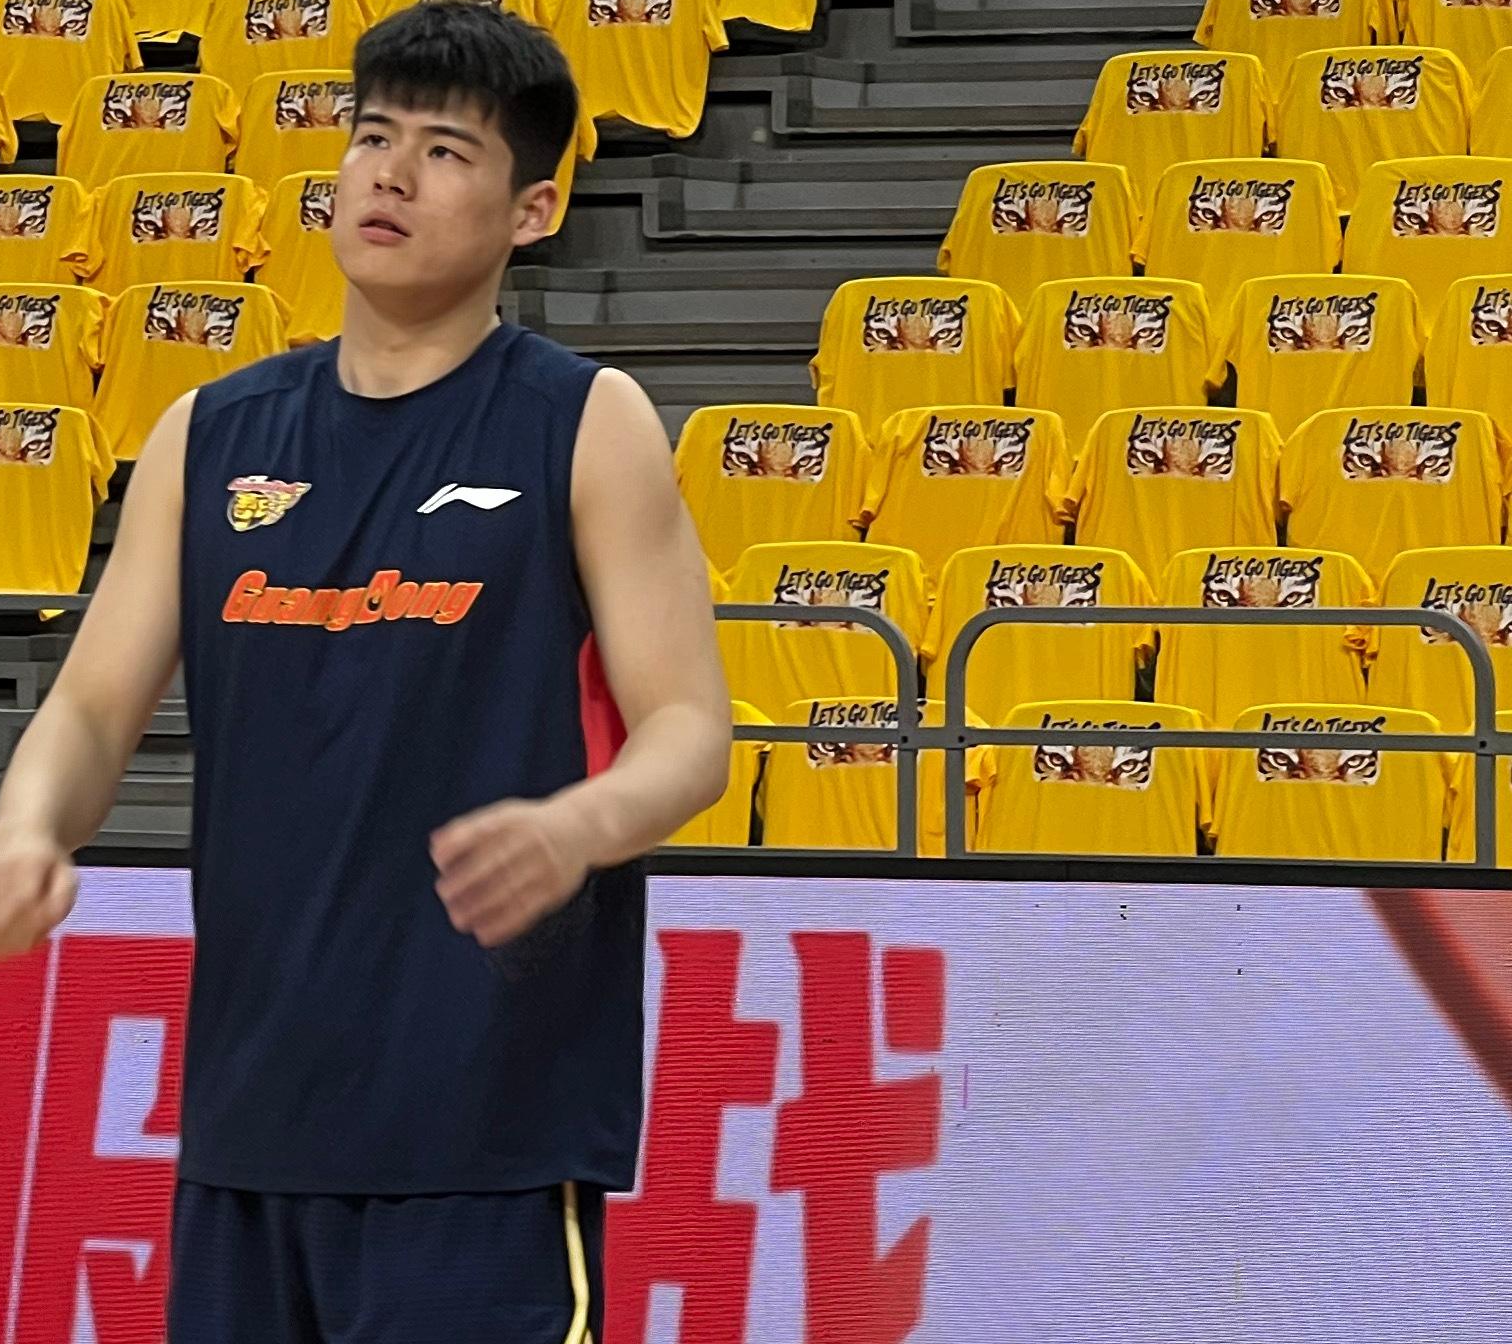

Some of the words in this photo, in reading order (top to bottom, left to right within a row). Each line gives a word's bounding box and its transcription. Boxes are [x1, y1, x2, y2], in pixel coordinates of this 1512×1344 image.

[1126, 62, 1161, 85] LET'S
[1161, 63, 1178, 79] GO
[1180, 59, 1227, 84] TIGERS
[1320, 56, 1356, 80] LET'S
[1357, 59, 1374, 75] GO
[1376, 56, 1424, 80] TIGERS
[10, 185, 54, 210] TIGERS
[992, 178, 1028, 202] LET'S
[1028, 181, 1046, 198] GO
[1048, 181, 1095, 206] TIGERS
[1189, 176, 1226, 199] LET'S
[1226, 180, 1244, 196] GO
[1245, 179, 1294, 204] TIGERS
[1393, 180, 1431, 205] LET'S
[1432, 183, 1450, 200] GO
[1452, 180, 1503, 206] TIGERS
[862, 295, 899, 320] LET'S
[900, 298, 918, 316] GO
[920, 295, 969, 321] TIGERS
[1064, 290, 1102, 315] LET'S
[1102, 295, 1121, 312] GO
[1123, 295, 1173, 320] TIGERS
[723, 417, 761, 443] LET'S
[761, 422, 780, 440] GO
[782, 422, 833, 449] TIGERS
[923, 416, 962, 442] LET'S
[962, 419, 981, 438] GO
[983, 417, 1034, 445] TIGERS
[1127, 414, 1167, 440] LET'S
[1167, 419, 1186, 438] GO
[1188, 420, 1241, 446] TIGERS
[1343, 418, 1384, 444] LET'S
[1384, 422, 1404, 440] GO
[1406, 421, 1460, 448] TIGERS
